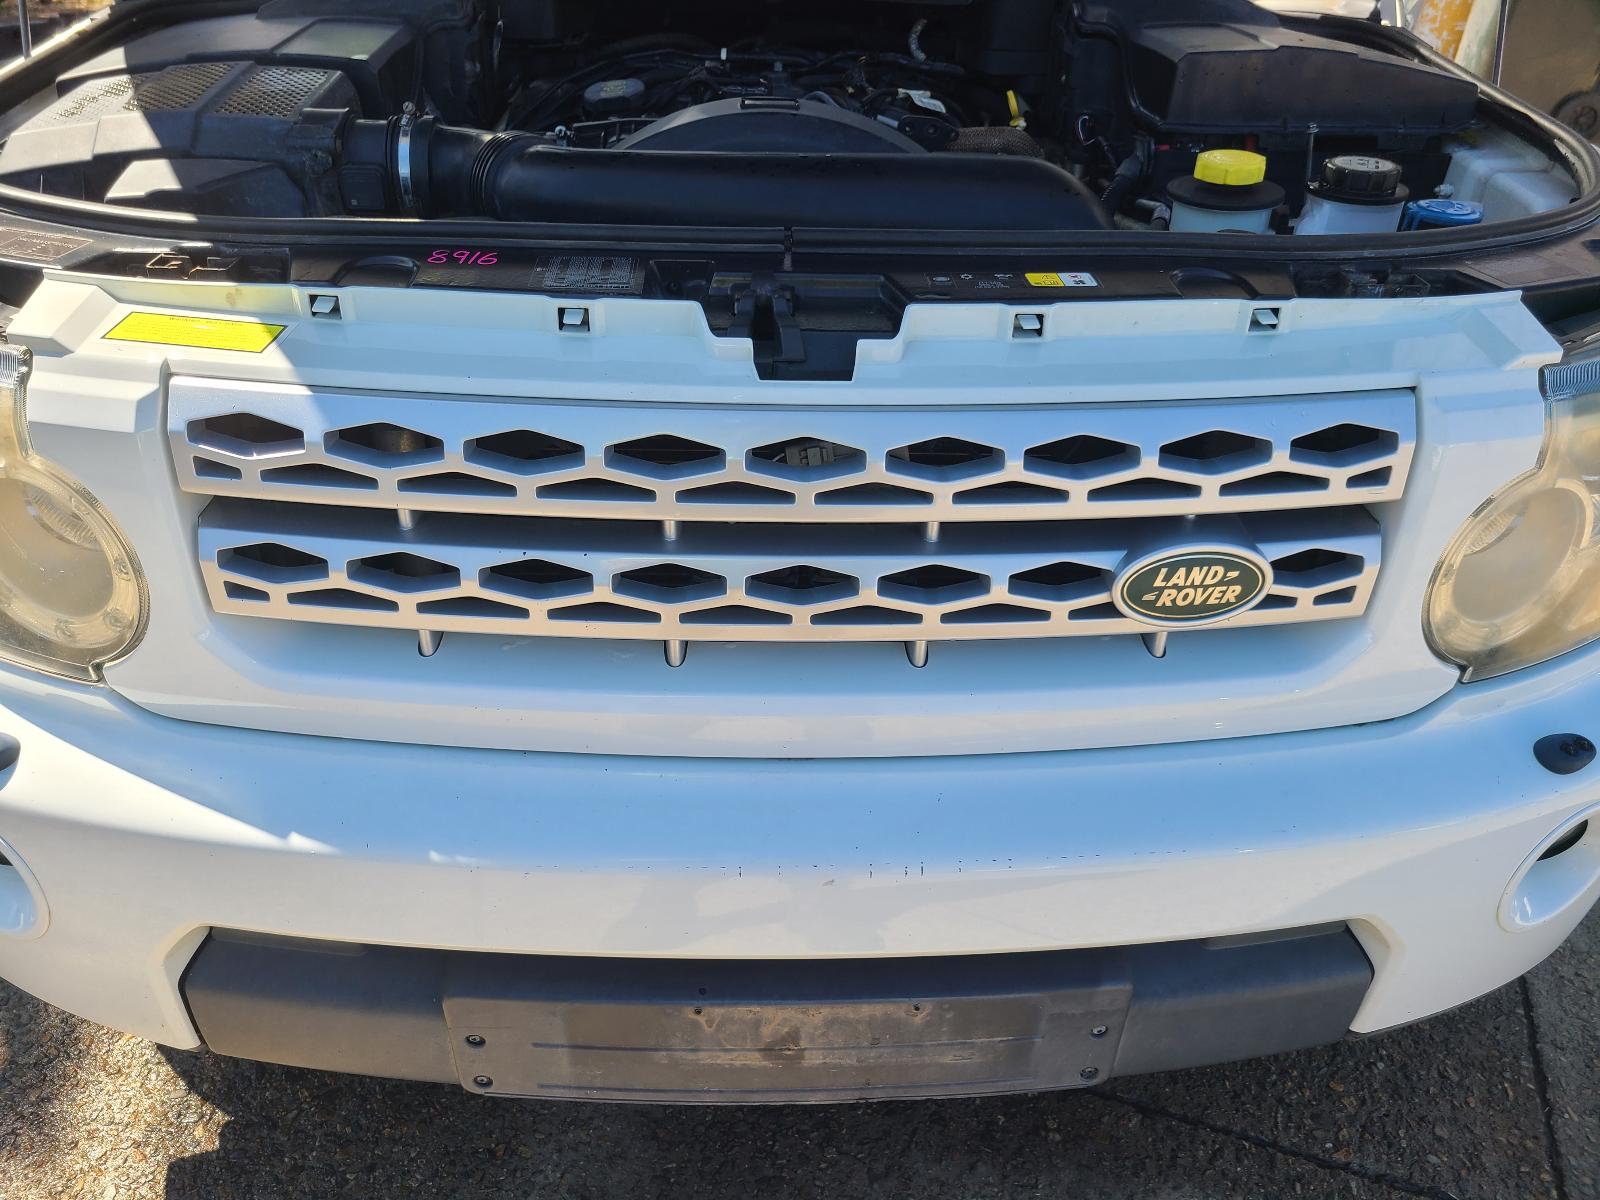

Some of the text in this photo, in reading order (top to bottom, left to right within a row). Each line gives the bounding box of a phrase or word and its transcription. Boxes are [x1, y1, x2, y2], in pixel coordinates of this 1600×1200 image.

[427, 249, 498, 265] 8916
[1152, 565, 1225, 588] LAND
[1155, 585, 1243, 608] ROVER
